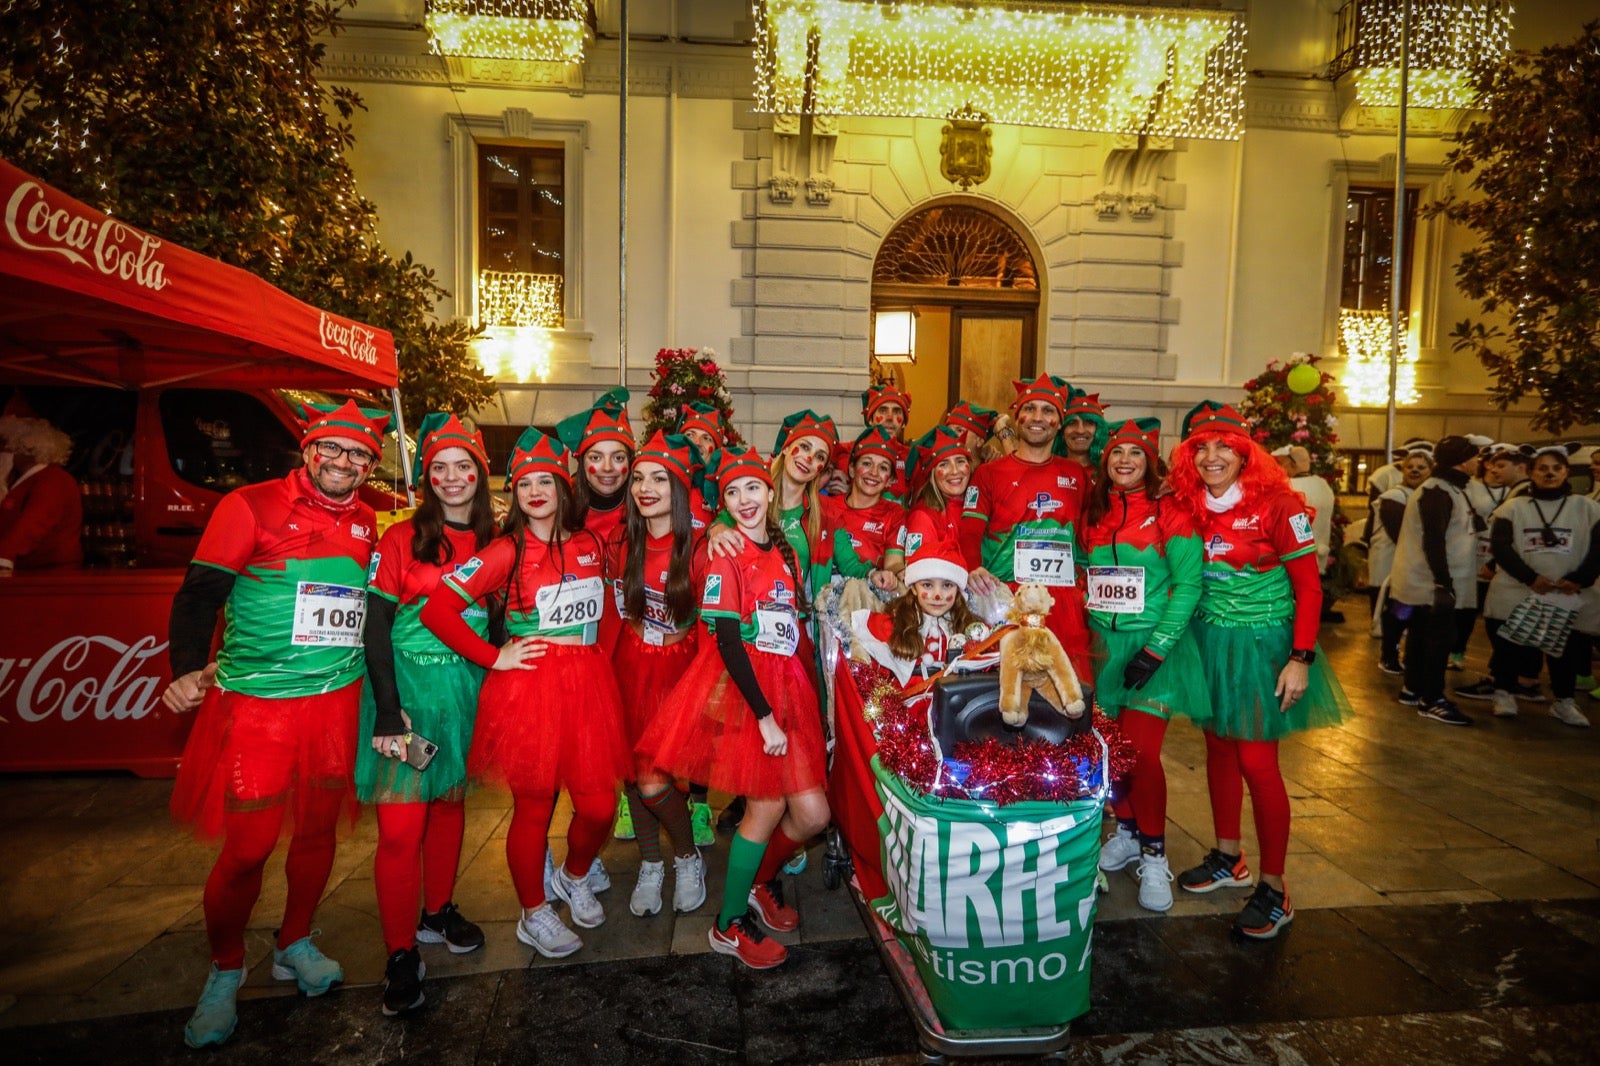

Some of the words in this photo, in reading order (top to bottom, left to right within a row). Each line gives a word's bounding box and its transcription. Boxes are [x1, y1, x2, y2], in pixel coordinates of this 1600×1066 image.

[5, 181, 168, 291] Coca-Cola
[319, 311, 378, 366] Coca-Cola
[1030, 558, 1064, 573] 977
[1097, 583, 1137, 600] 1088
[312, 608, 363, 630] 1087
[549, 599, 597, 625] 4280
